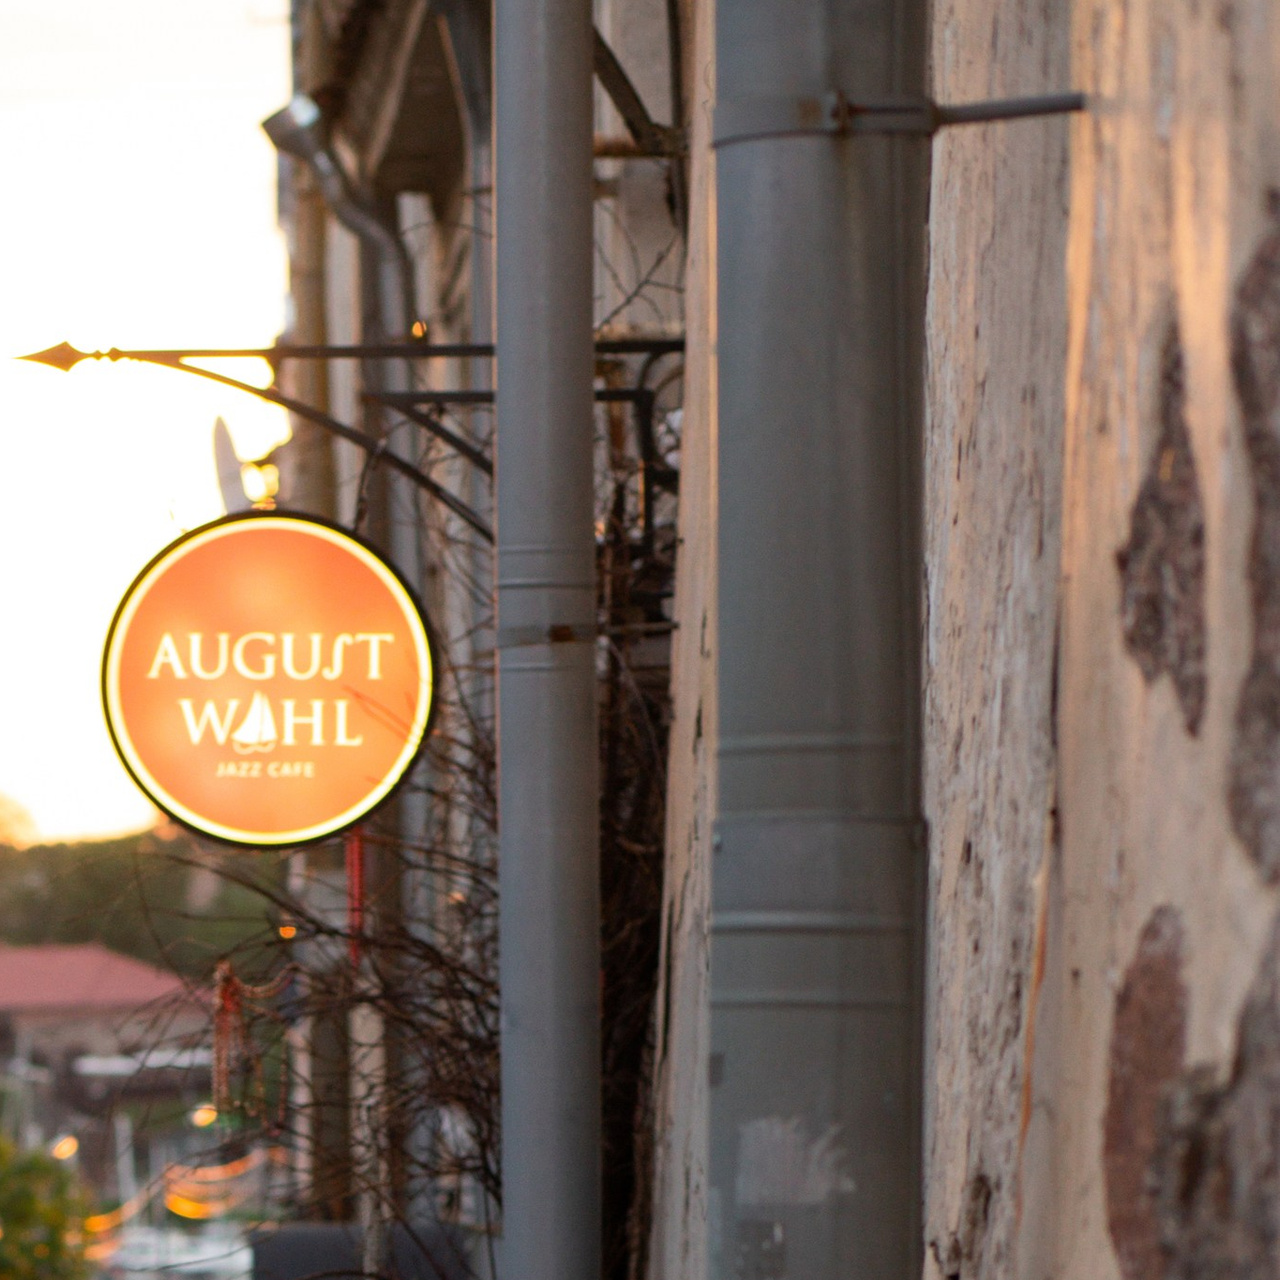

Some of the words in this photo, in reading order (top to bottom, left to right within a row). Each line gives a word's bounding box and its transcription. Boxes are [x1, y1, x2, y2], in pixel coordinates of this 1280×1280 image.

[146, 631, 395, 681] AUGUST
[178, 690, 364, 751] WAHL
[216, 761, 262, 778] JAZZ
[267, 761, 315, 778] CAFE
